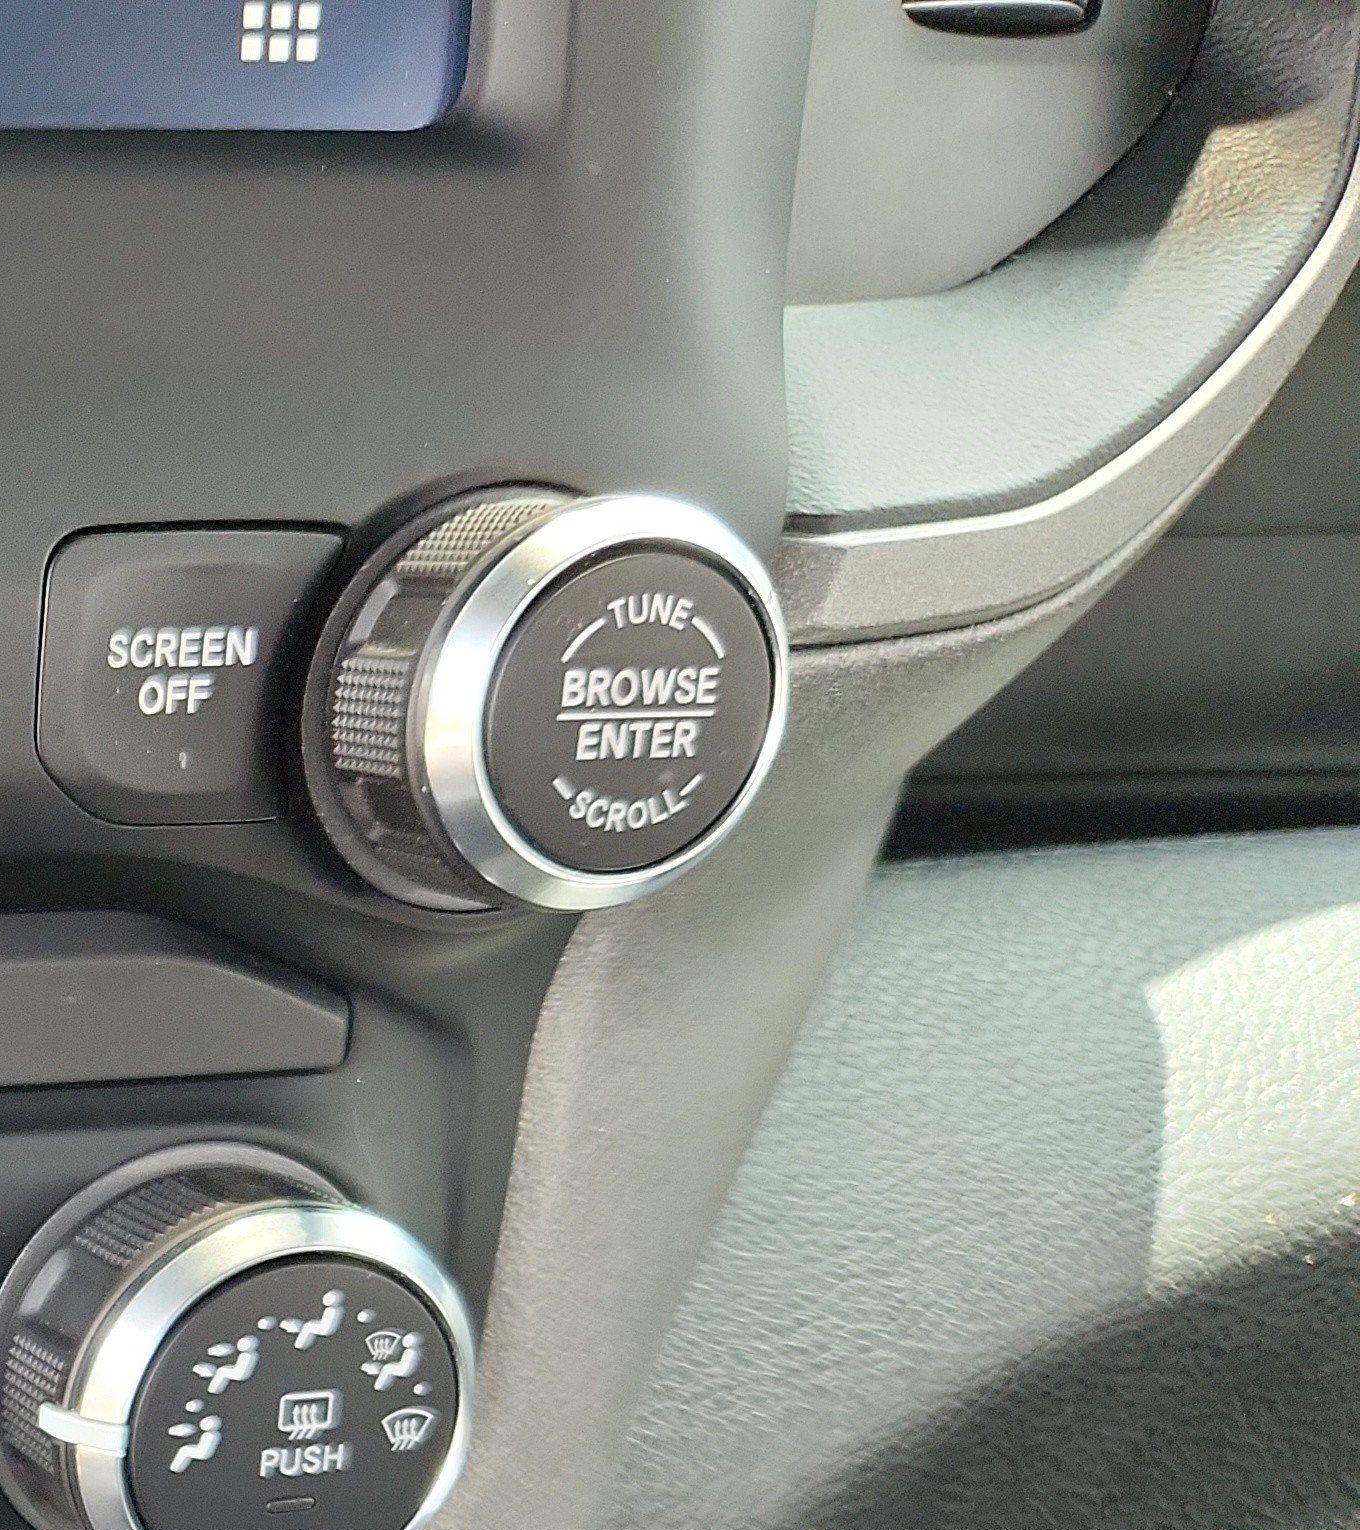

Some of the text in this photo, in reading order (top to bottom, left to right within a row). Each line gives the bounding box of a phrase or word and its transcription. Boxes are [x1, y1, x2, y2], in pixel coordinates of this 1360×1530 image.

[607, 593, 693, 631] TUNE
[107, 626, 259, 669] SCREEN
[138, 673, 215, 715] OFF
[561, 667, 720, 708] BROWSE
[576, 720, 700, 761] ENTER
[569, 790, 690, 832] SCROLL
[259, 1443, 348, 1478] PUSH
